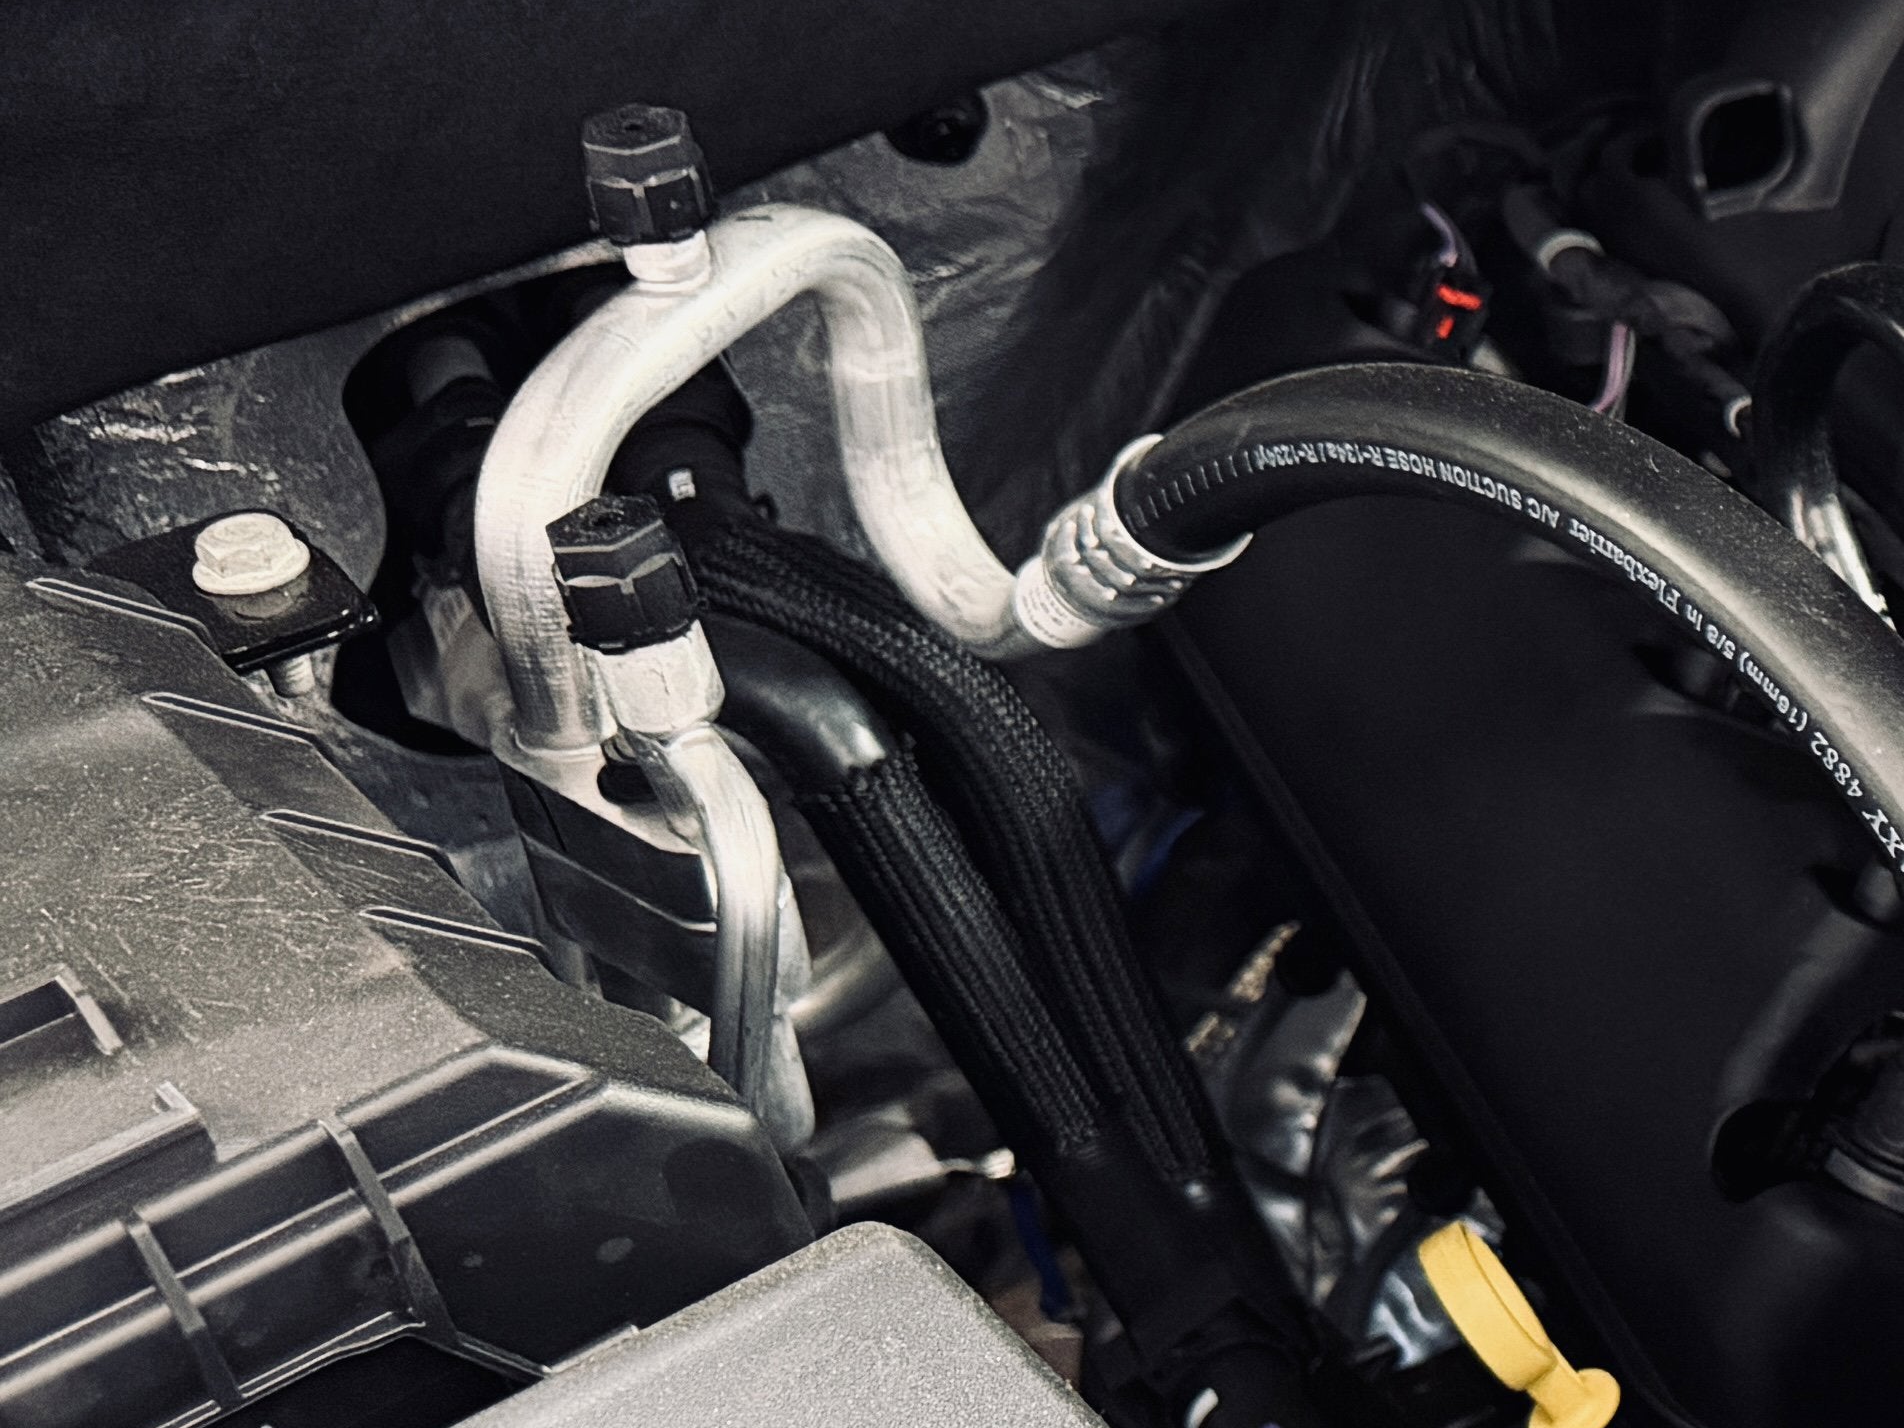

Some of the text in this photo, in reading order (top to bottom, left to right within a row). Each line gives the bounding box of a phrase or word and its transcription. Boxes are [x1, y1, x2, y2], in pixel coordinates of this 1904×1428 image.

[1382, 446, 1438, 479] HOSE
[1439, 467, 1523, 511] SUCTION
[1524, 496, 1560, 529] A/C
[1568, 517, 1681, 615] Flexbarrier
[1705, 623, 1736, 660] 5/8
[1738, 651, 1808, 732] (16mm)
[1809, 731, 1863, 797] 4882
